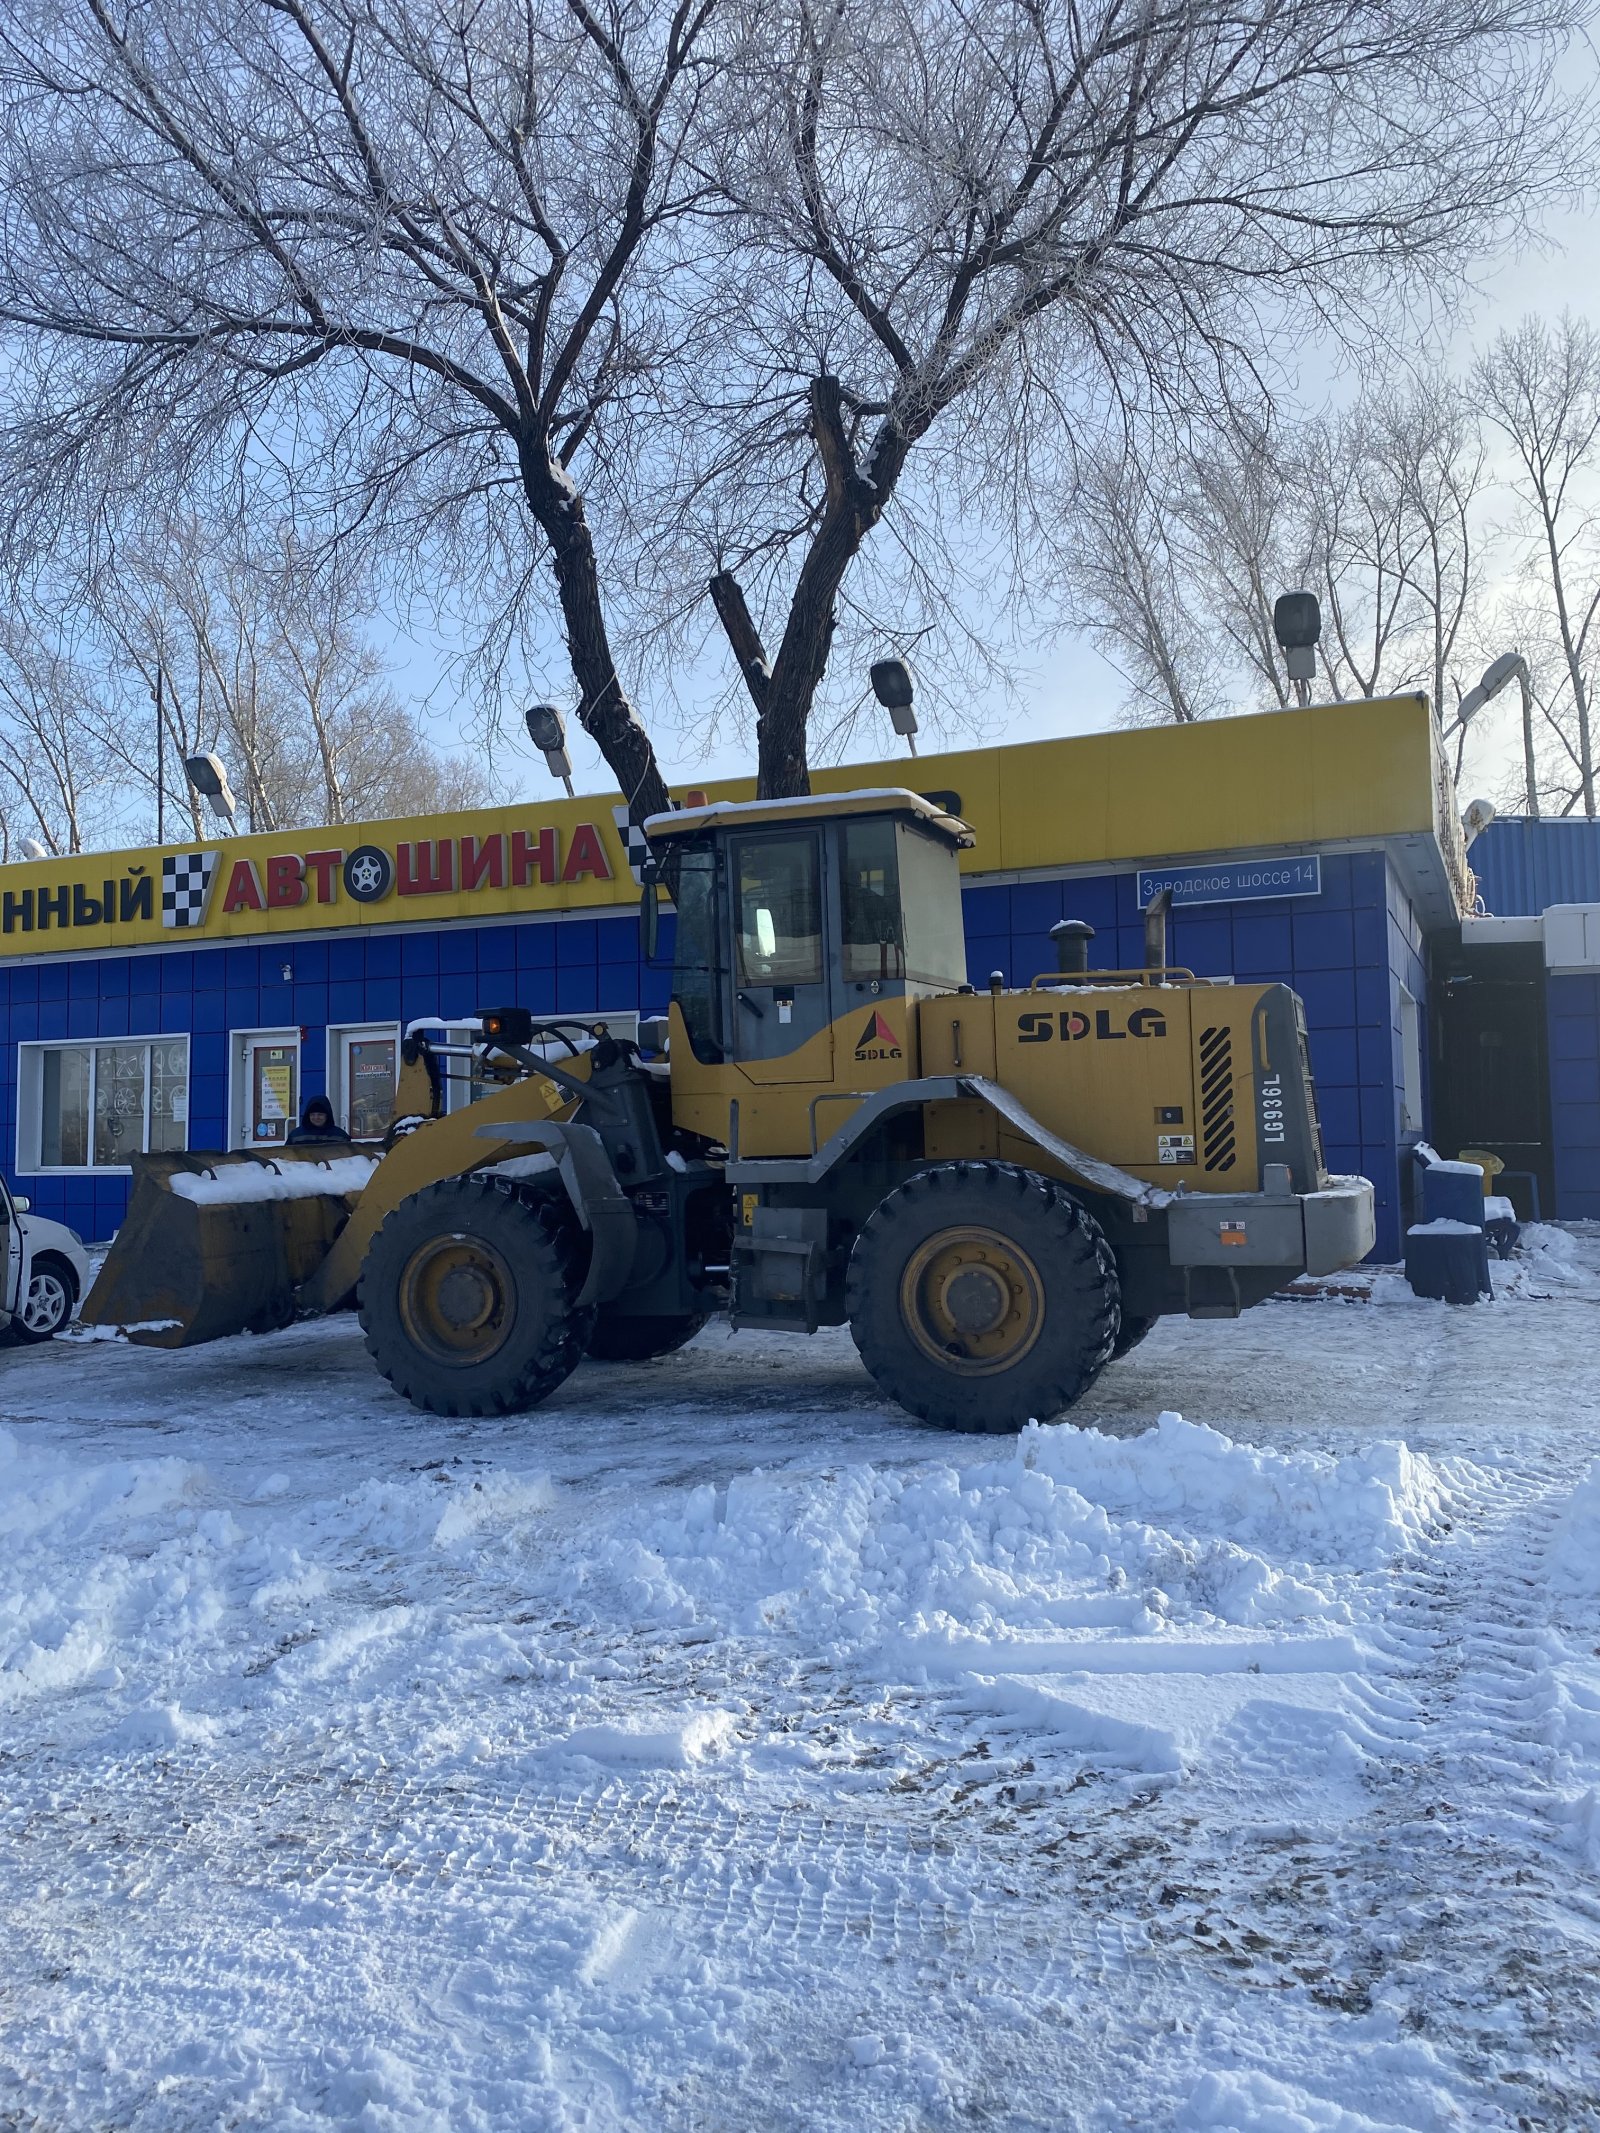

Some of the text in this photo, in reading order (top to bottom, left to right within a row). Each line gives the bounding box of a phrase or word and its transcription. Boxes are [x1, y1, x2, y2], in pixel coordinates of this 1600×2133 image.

[1237, 870, 1291, 888] шоссе
[1294, 864, 1314, 883] 14
[1017, 1007, 1167, 1043] SDLG
[854, 1047, 902, 1061] SDLG
[1261, 1073, 1285, 1143] LG936L
